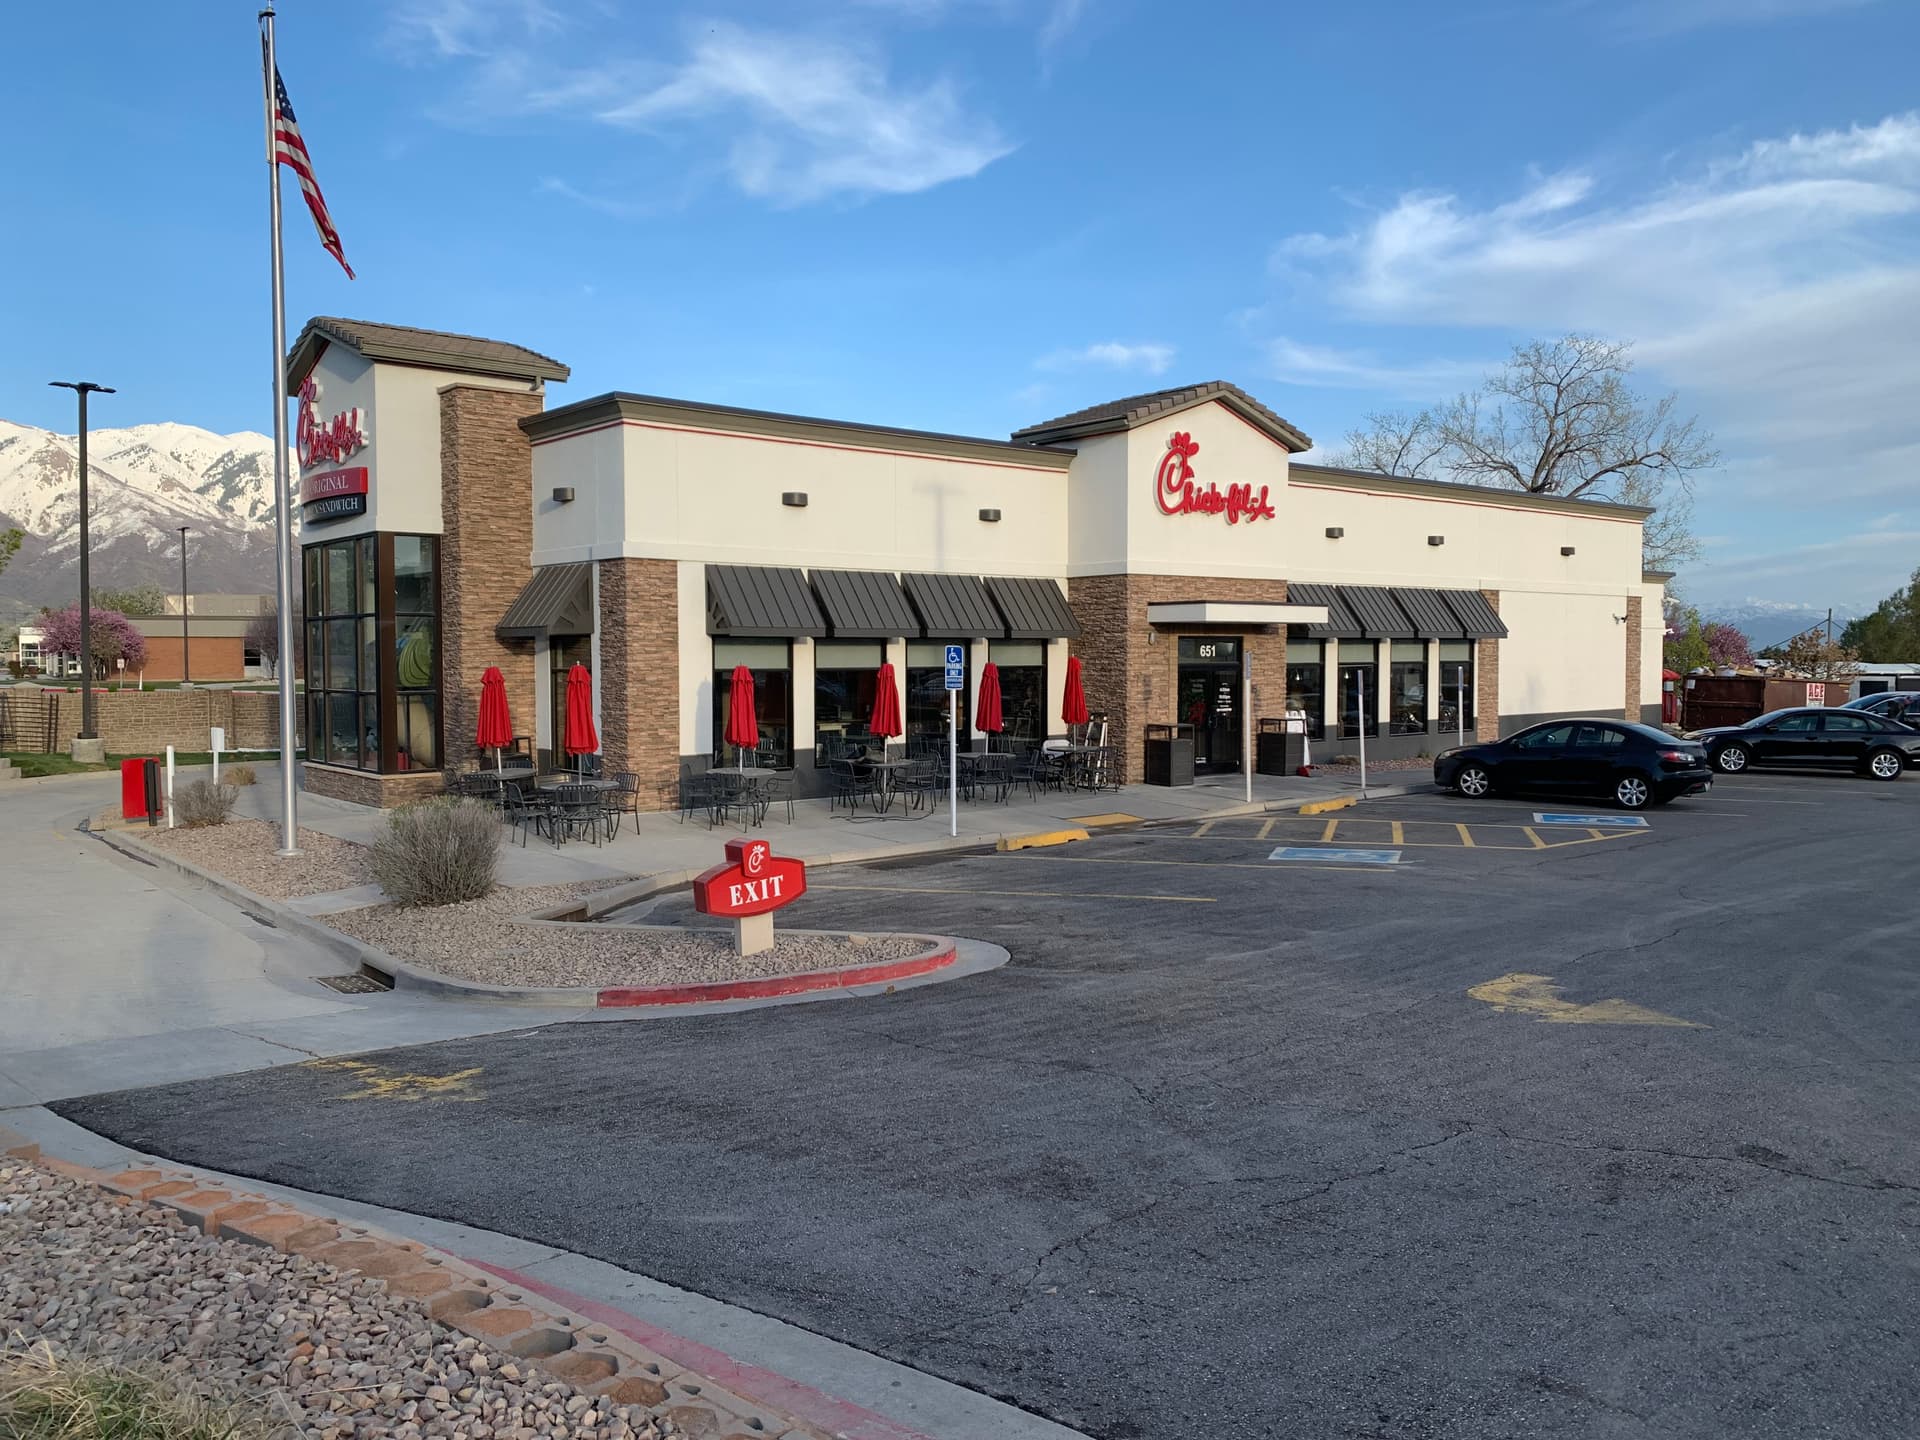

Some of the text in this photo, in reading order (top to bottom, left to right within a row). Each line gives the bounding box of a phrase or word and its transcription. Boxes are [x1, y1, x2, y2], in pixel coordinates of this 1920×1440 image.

[1156, 431, 1275, 525] Chick-fil-A
[319, 497, 358, 513] SANDWICH
[1200, 645, 1216, 657] 651
[729, 874, 784, 907] EXIT
